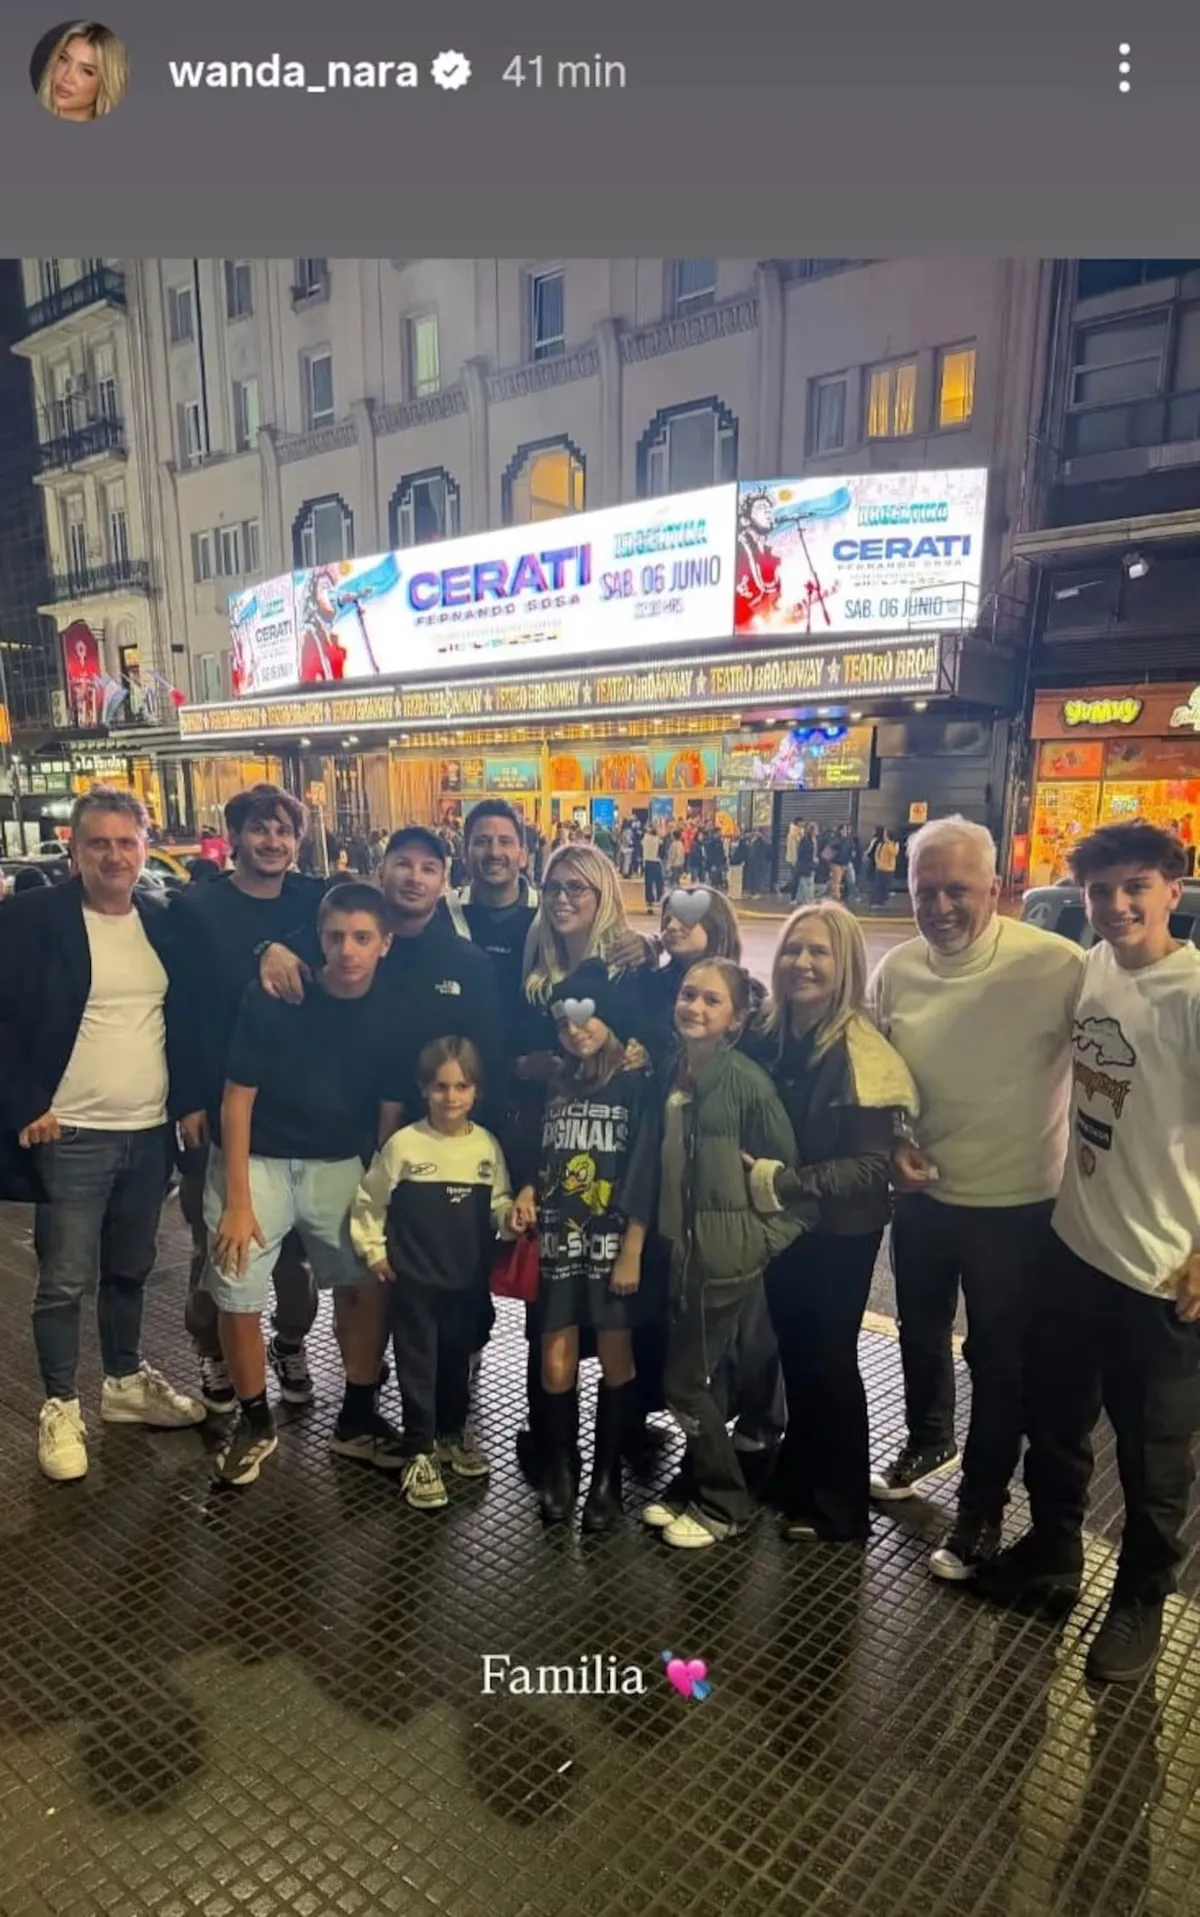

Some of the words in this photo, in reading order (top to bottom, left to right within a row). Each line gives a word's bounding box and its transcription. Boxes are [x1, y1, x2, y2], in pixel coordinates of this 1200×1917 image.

[832, 534, 971, 562] CERATI
[407, 543, 592, 612] CERATI
[599, 568, 637, 601] SAB.
[642, 562, 666, 596] 06
[668, 554, 721, 593] JUNIO
[845, 599, 875, 620] SAB.
[879, 598, 898, 619] 06
[902, 595, 943, 617] JUNIO
[255, 620, 293, 643] CERATI
[711, 664, 751, 694] TEATRO
[754, 657, 825, 691] BROADWAY
[843, 649, 893, 685] TEATRO
